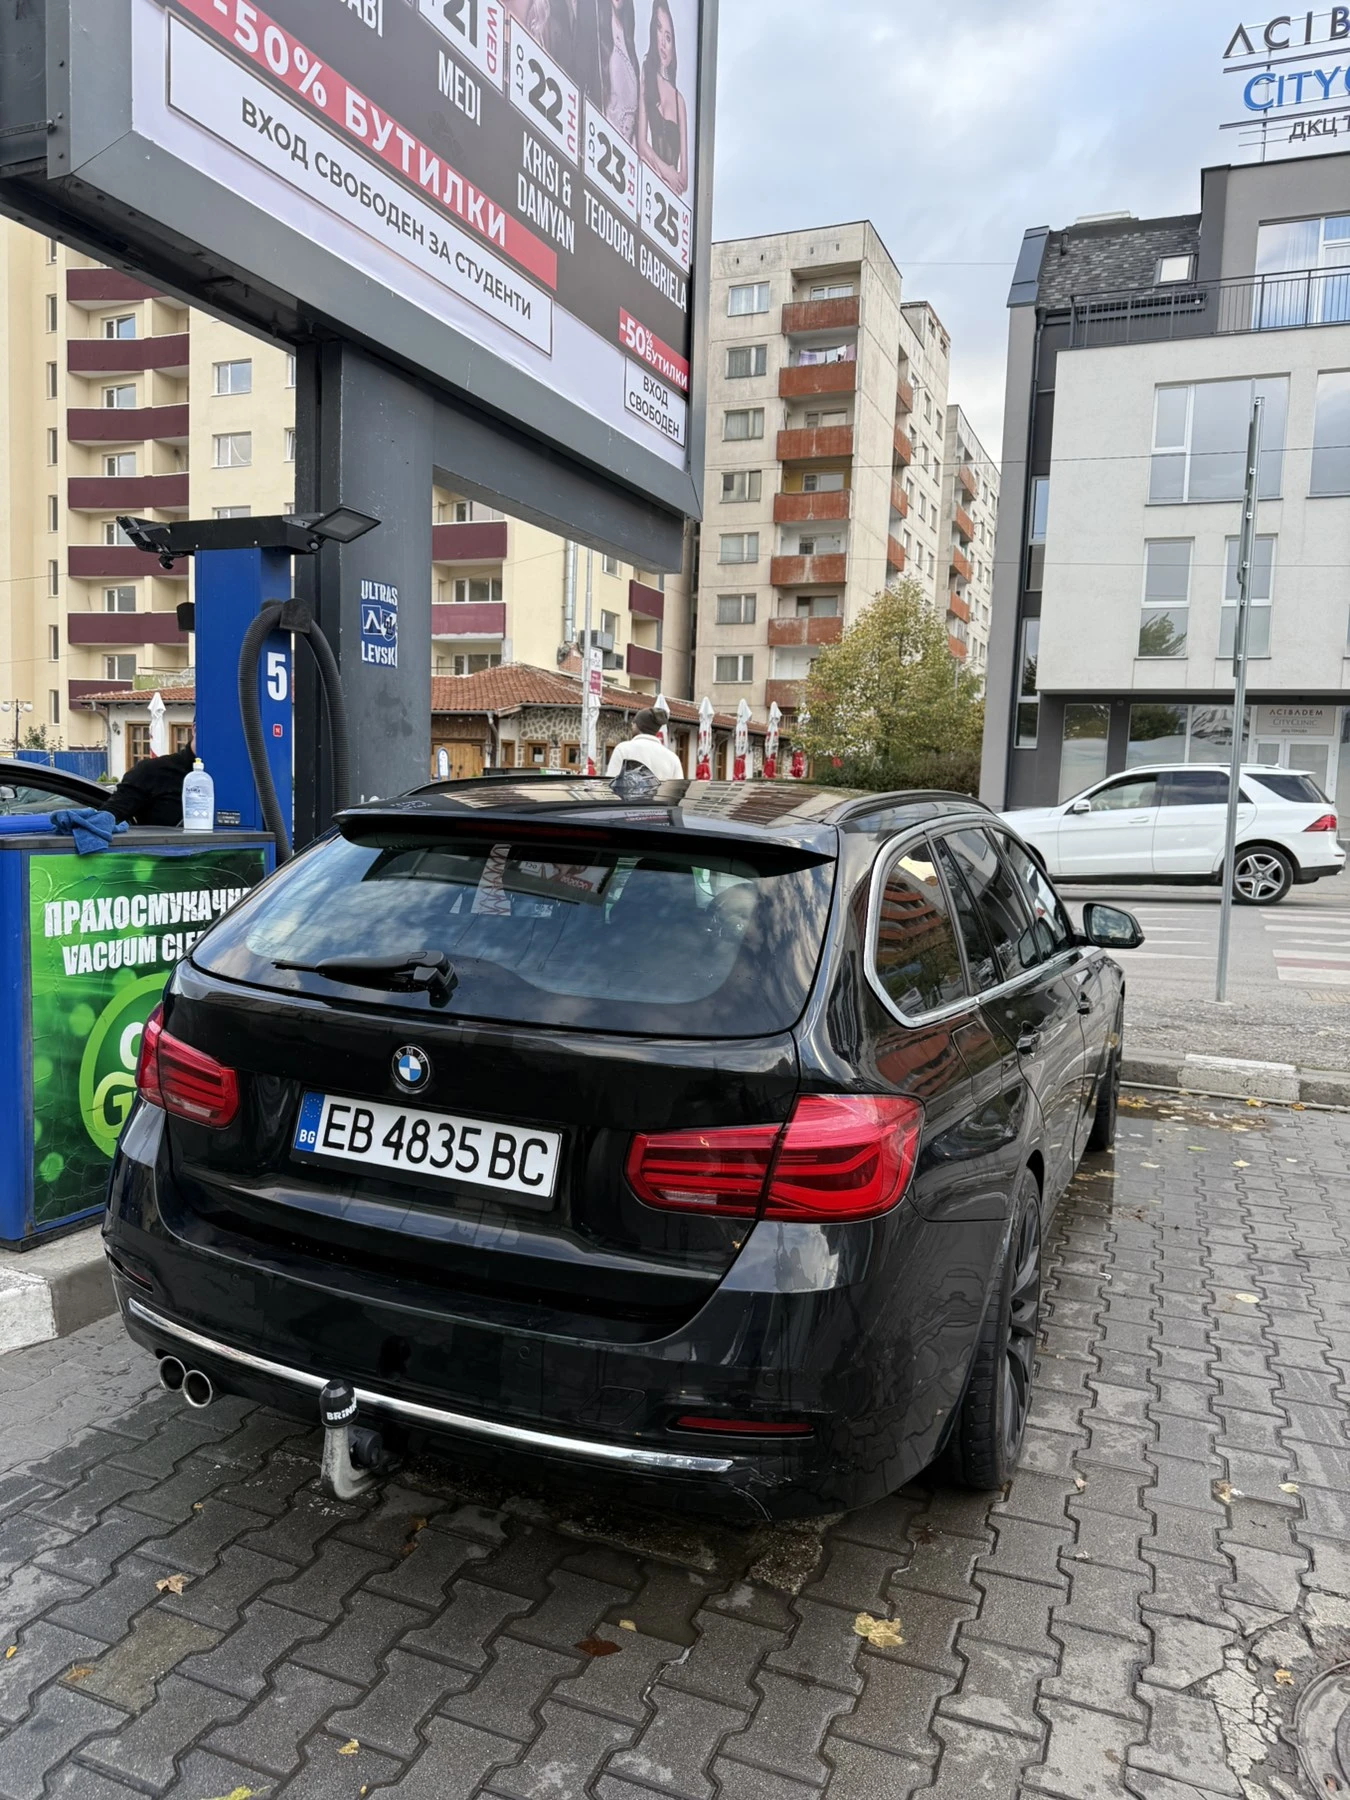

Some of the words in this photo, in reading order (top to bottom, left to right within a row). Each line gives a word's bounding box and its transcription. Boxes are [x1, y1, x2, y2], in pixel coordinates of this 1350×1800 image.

[486, 6, 498, 74] WED
[438, 50, 482, 126] MEDI
[516, 44, 525, 96] OCT
[528, 58, 563, 135] 22
[1243, 65, 1350, 111] CITY
[213, 0, 328, 108] -50%
[345, 86, 506, 247] БУТИЛКИ
[567, 92, 577, 155] THU
[1288, 116, 1338, 143] ДКЦ
[523, 131, 559, 198] KRISI
[562, 170, 572, 209] &
[597, 131, 626, 195] 23
[627, 161, 636, 208] FRI
[241, 96, 309, 170] ВХОД
[315, 152, 424, 245] СВОБОДЕН
[429, 231, 451, 265] ЗА
[455, 251, 532, 320] СТУДЕНТИ
[517, 172, 575, 254] DAMYAN
[583, 188, 636, 267] TEODORA
[654, 191, 679, 248] 25
[681, 211, 689, 265] SUN
[640, 243, 687, 313] GABRIELA
[643, 375, 669, 410] ВХОД
[645, 346, 688, 390] БУТИЛКИ
[629, 391, 680, 439] СВОБОДЕН
[361, 580, 398, 605] ULTRAS
[266, 651, 288, 701] 5
[361, 640, 398, 668] LEVSKI
[1269, 708, 1324, 716] ACIBADEM
[62, 935, 157, 976] VACUUM
[162, 931, 206, 962] CLE
[395, 1047, 426, 1063] BMW
[299, 1129, 316, 1145] BG
[322, 1103, 374, 1153] EB
[382, 1115, 482, 1173] 4835
[487, 1131, 548, 1187] BC
